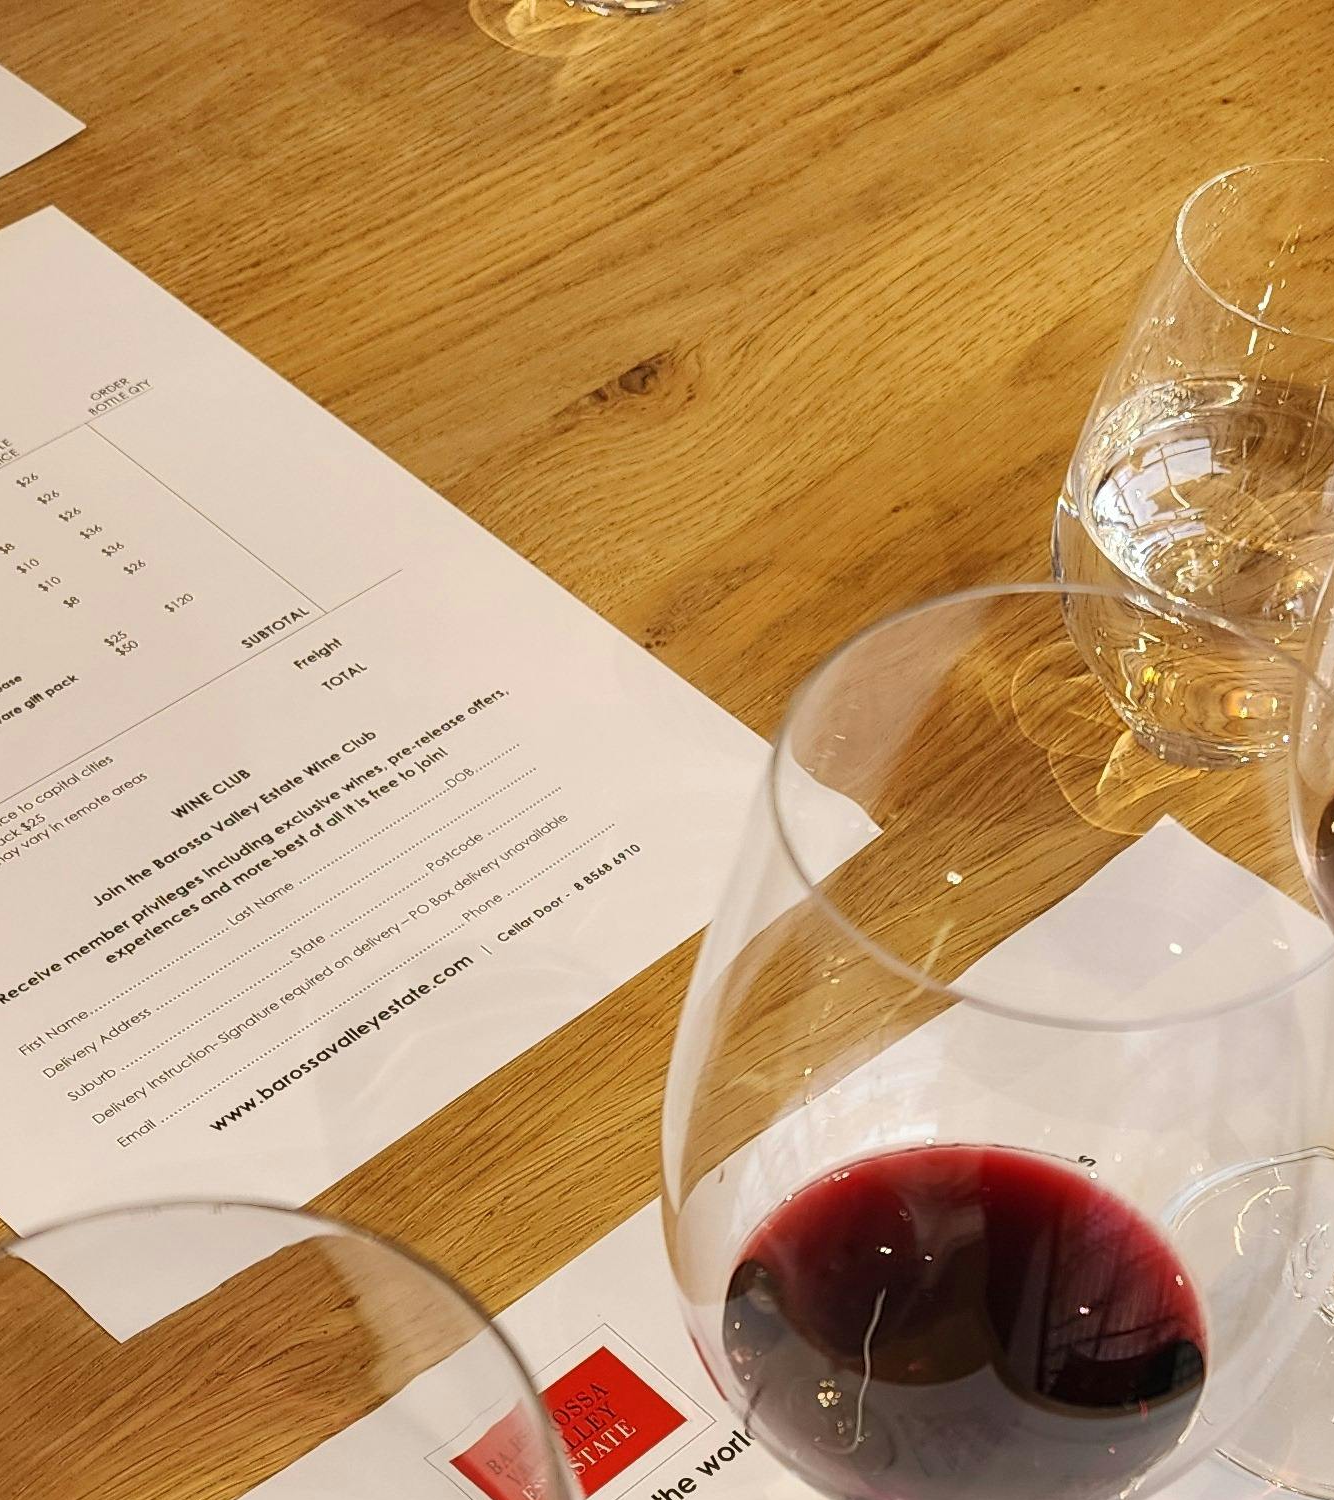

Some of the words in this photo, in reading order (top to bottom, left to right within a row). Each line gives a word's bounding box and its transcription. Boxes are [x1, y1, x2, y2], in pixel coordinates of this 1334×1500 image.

[240, 606, 310, 649] SUBTOTAL
[292, 636, 343, 670] Freight
[320, 662, 368, 691] TOTAL
[92, 883, 127, 907] Join
[123, 867, 153, 887] the
[150, 830, 214, 870] Barossa
[208, 800, 260, 832] Valley
[257, 775, 305, 805] Estate
[300, 752, 342, 777] Wine
[340, 731, 377, 754] Club
[169, 790, 213, 819] WINE
[211, 768, 251, 795] CLUB
[62, 918, 131, 965] member
[129, 875, 205, 926] privileges
[200, 832, 275, 879] including
[273, 790, 341, 835] exclusive
[339, 764, 388, 792] wines,
[385, 713, 467, 767] pre-release
[466, 689, 510, 715] offers,
[496, 915, 535, 942] Cellar
[531, 895, 564, 919] Door
[572, 881, 585, 891] 8
[581, 862, 613, 885] 8568
[611, 843, 641, 865] 6910
[208, 955, 474, 1131] www.barossavalleyestate.com
[693, 1427, 755, 1477] worl
